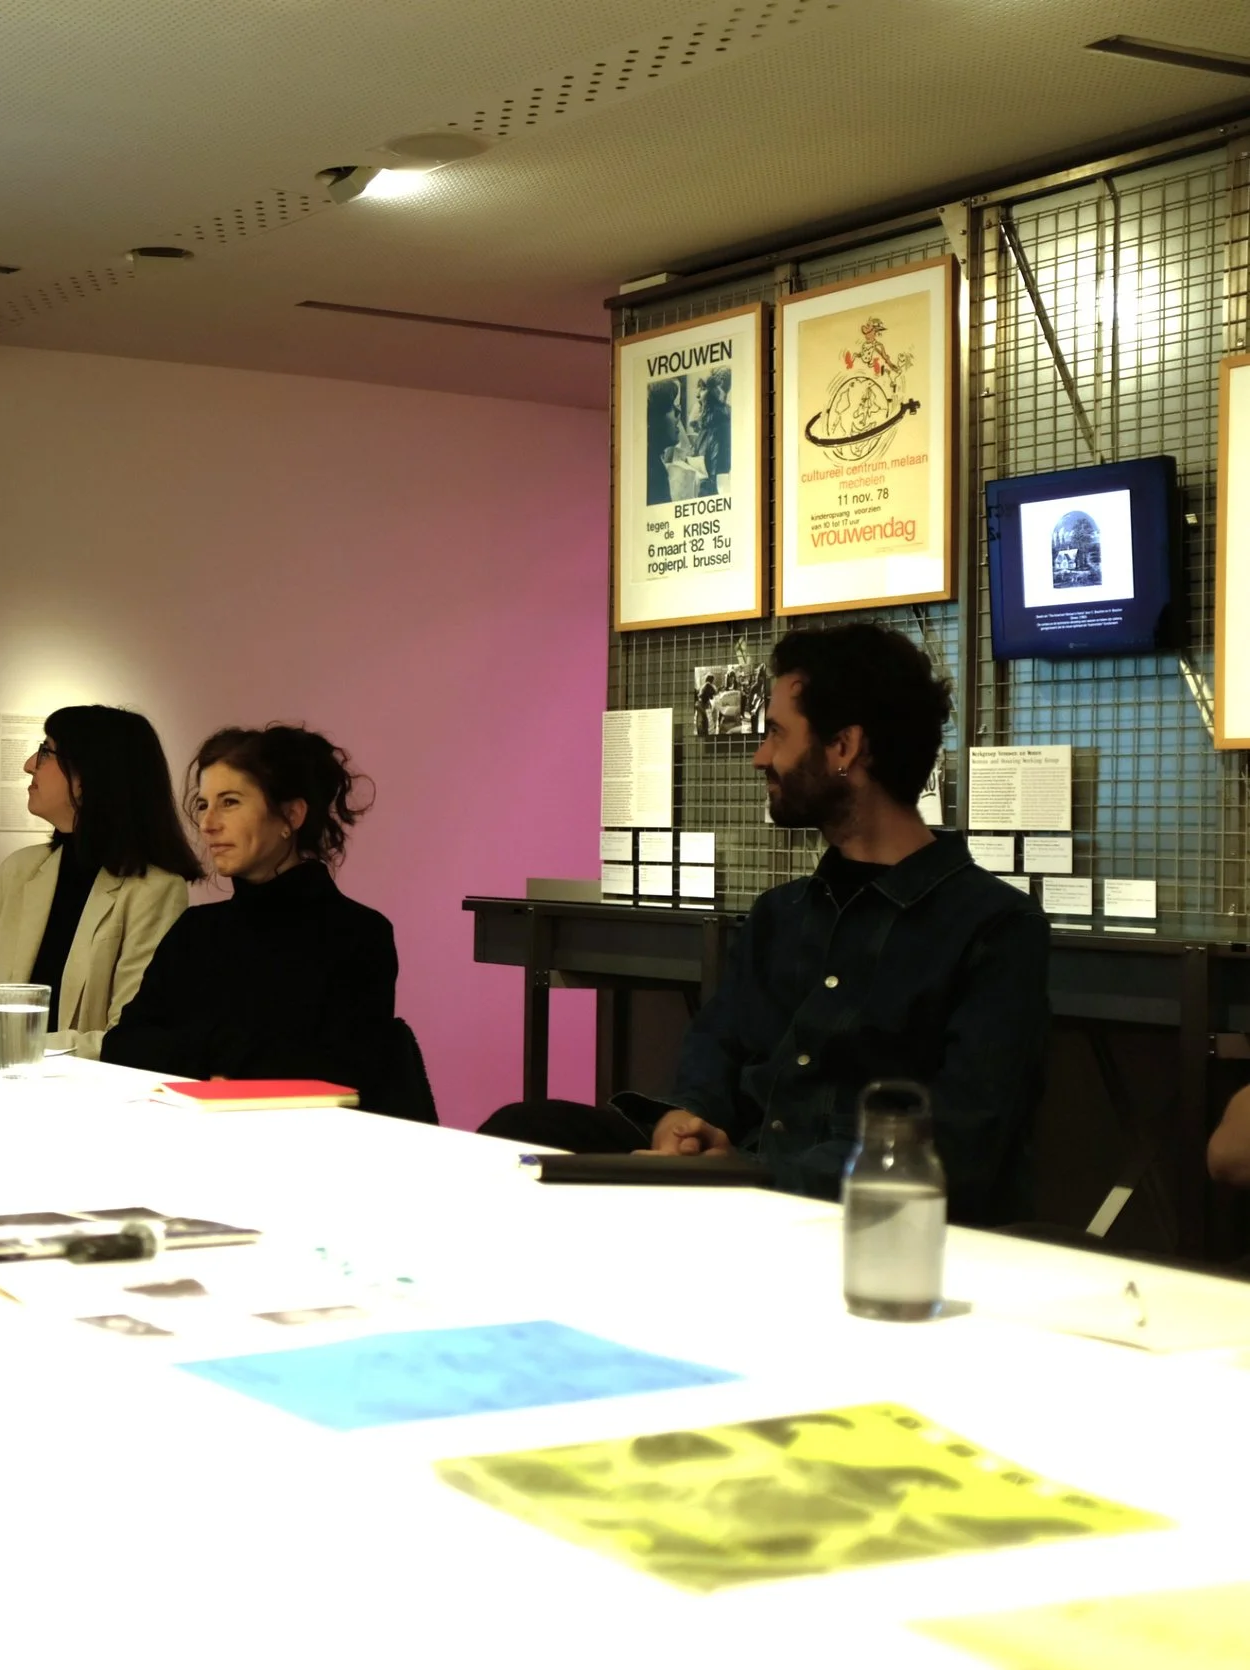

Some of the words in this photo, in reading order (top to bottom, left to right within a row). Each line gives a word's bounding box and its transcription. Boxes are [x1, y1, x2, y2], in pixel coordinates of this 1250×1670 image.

[647, 339, 732, 377] VROUWEN
[801, 466, 844, 483] cultureel
[891, 454, 928, 468] melaan
[839, 474, 885, 490] mechelen
[838, 494, 848, 506] 11
[852, 492, 873, 505] nov.
[877, 487, 889, 500] 78
[674, 497, 732, 518] BETOGEN
[854, 505, 881, 515] voorzien
[647, 520, 670, 533] tegen
[664, 530, 675, 540] de
[683, 519, 721, 538] KRISIS
[811, 523, 822, 531] van
[832, 519, 841, 528] tot
[842, 518, 848, 526] 17
[811, 516, 916, 548] vrouwendag
[648, 544, 655, 558] 6
[657, 540, 688, 557] maart
[648, 555, 689, 575] rogierpl.
[693, 550, 731, 568] brussel
